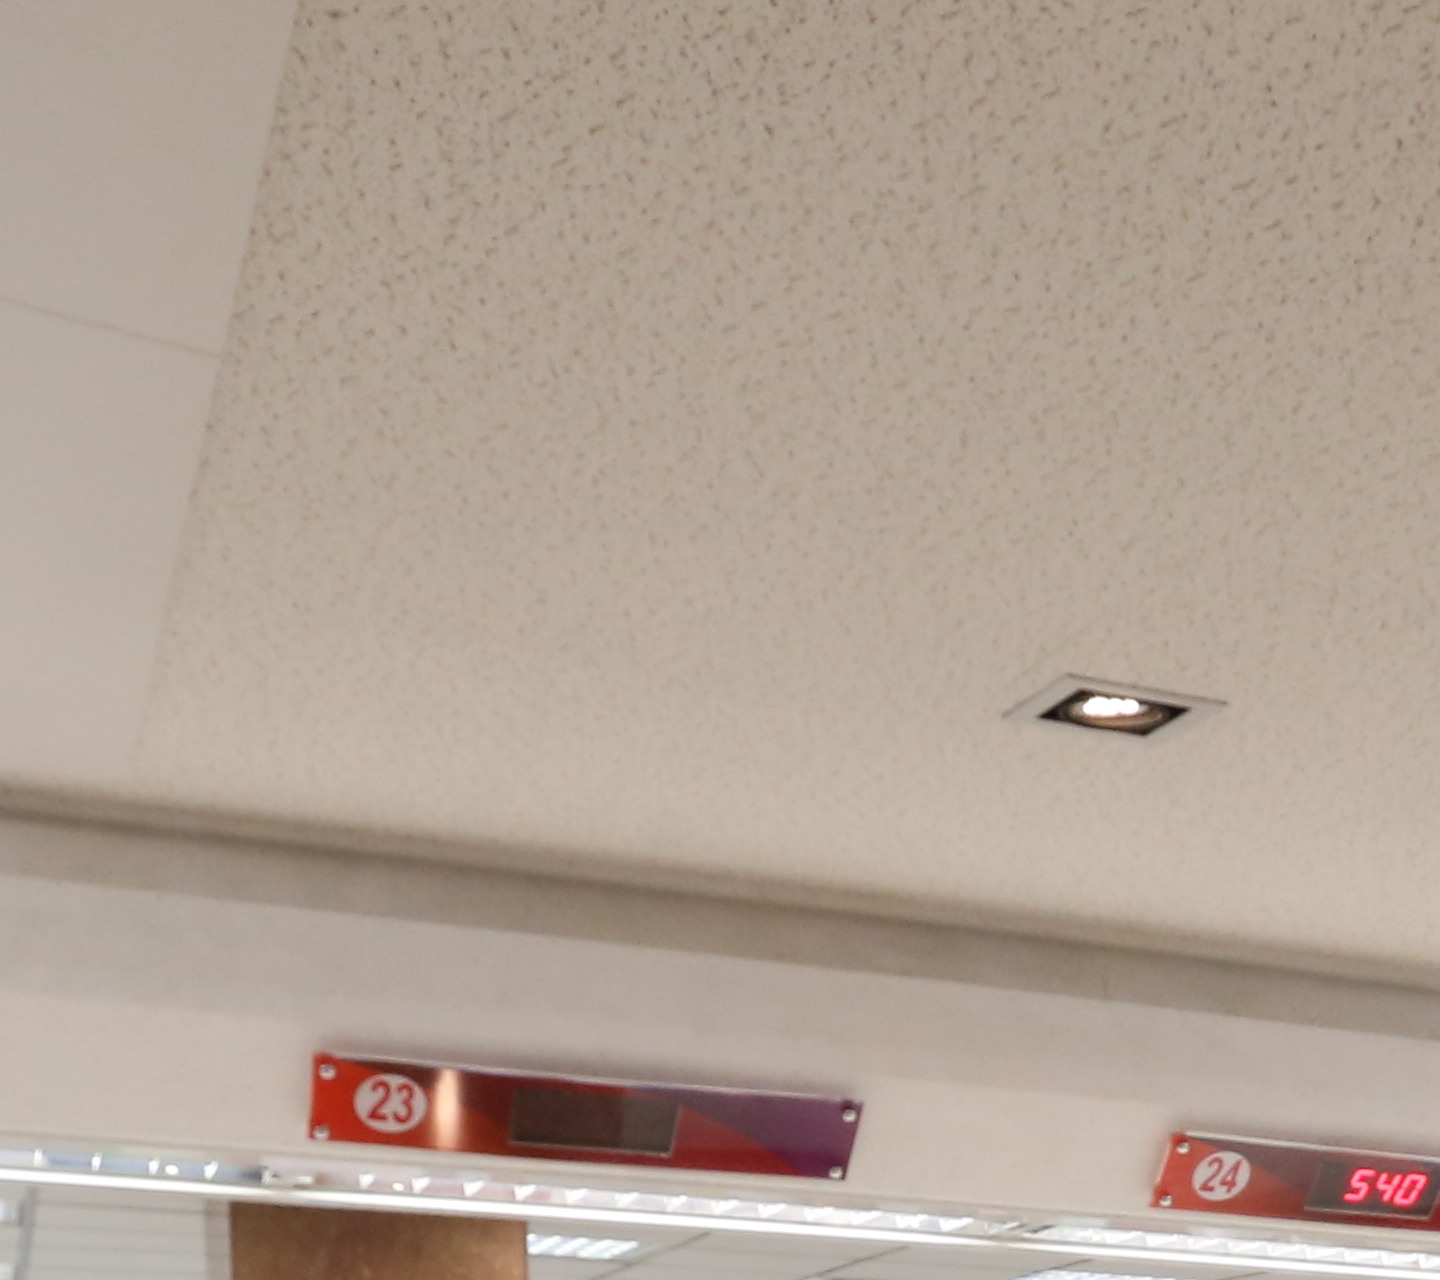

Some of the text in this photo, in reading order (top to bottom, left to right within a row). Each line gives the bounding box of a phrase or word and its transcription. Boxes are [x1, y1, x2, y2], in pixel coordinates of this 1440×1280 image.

[369, 1080, 415, 1123] 23
[1200, 1158, 1239, 1194] 24
[1344, 1168, 1428, 1206] 540
